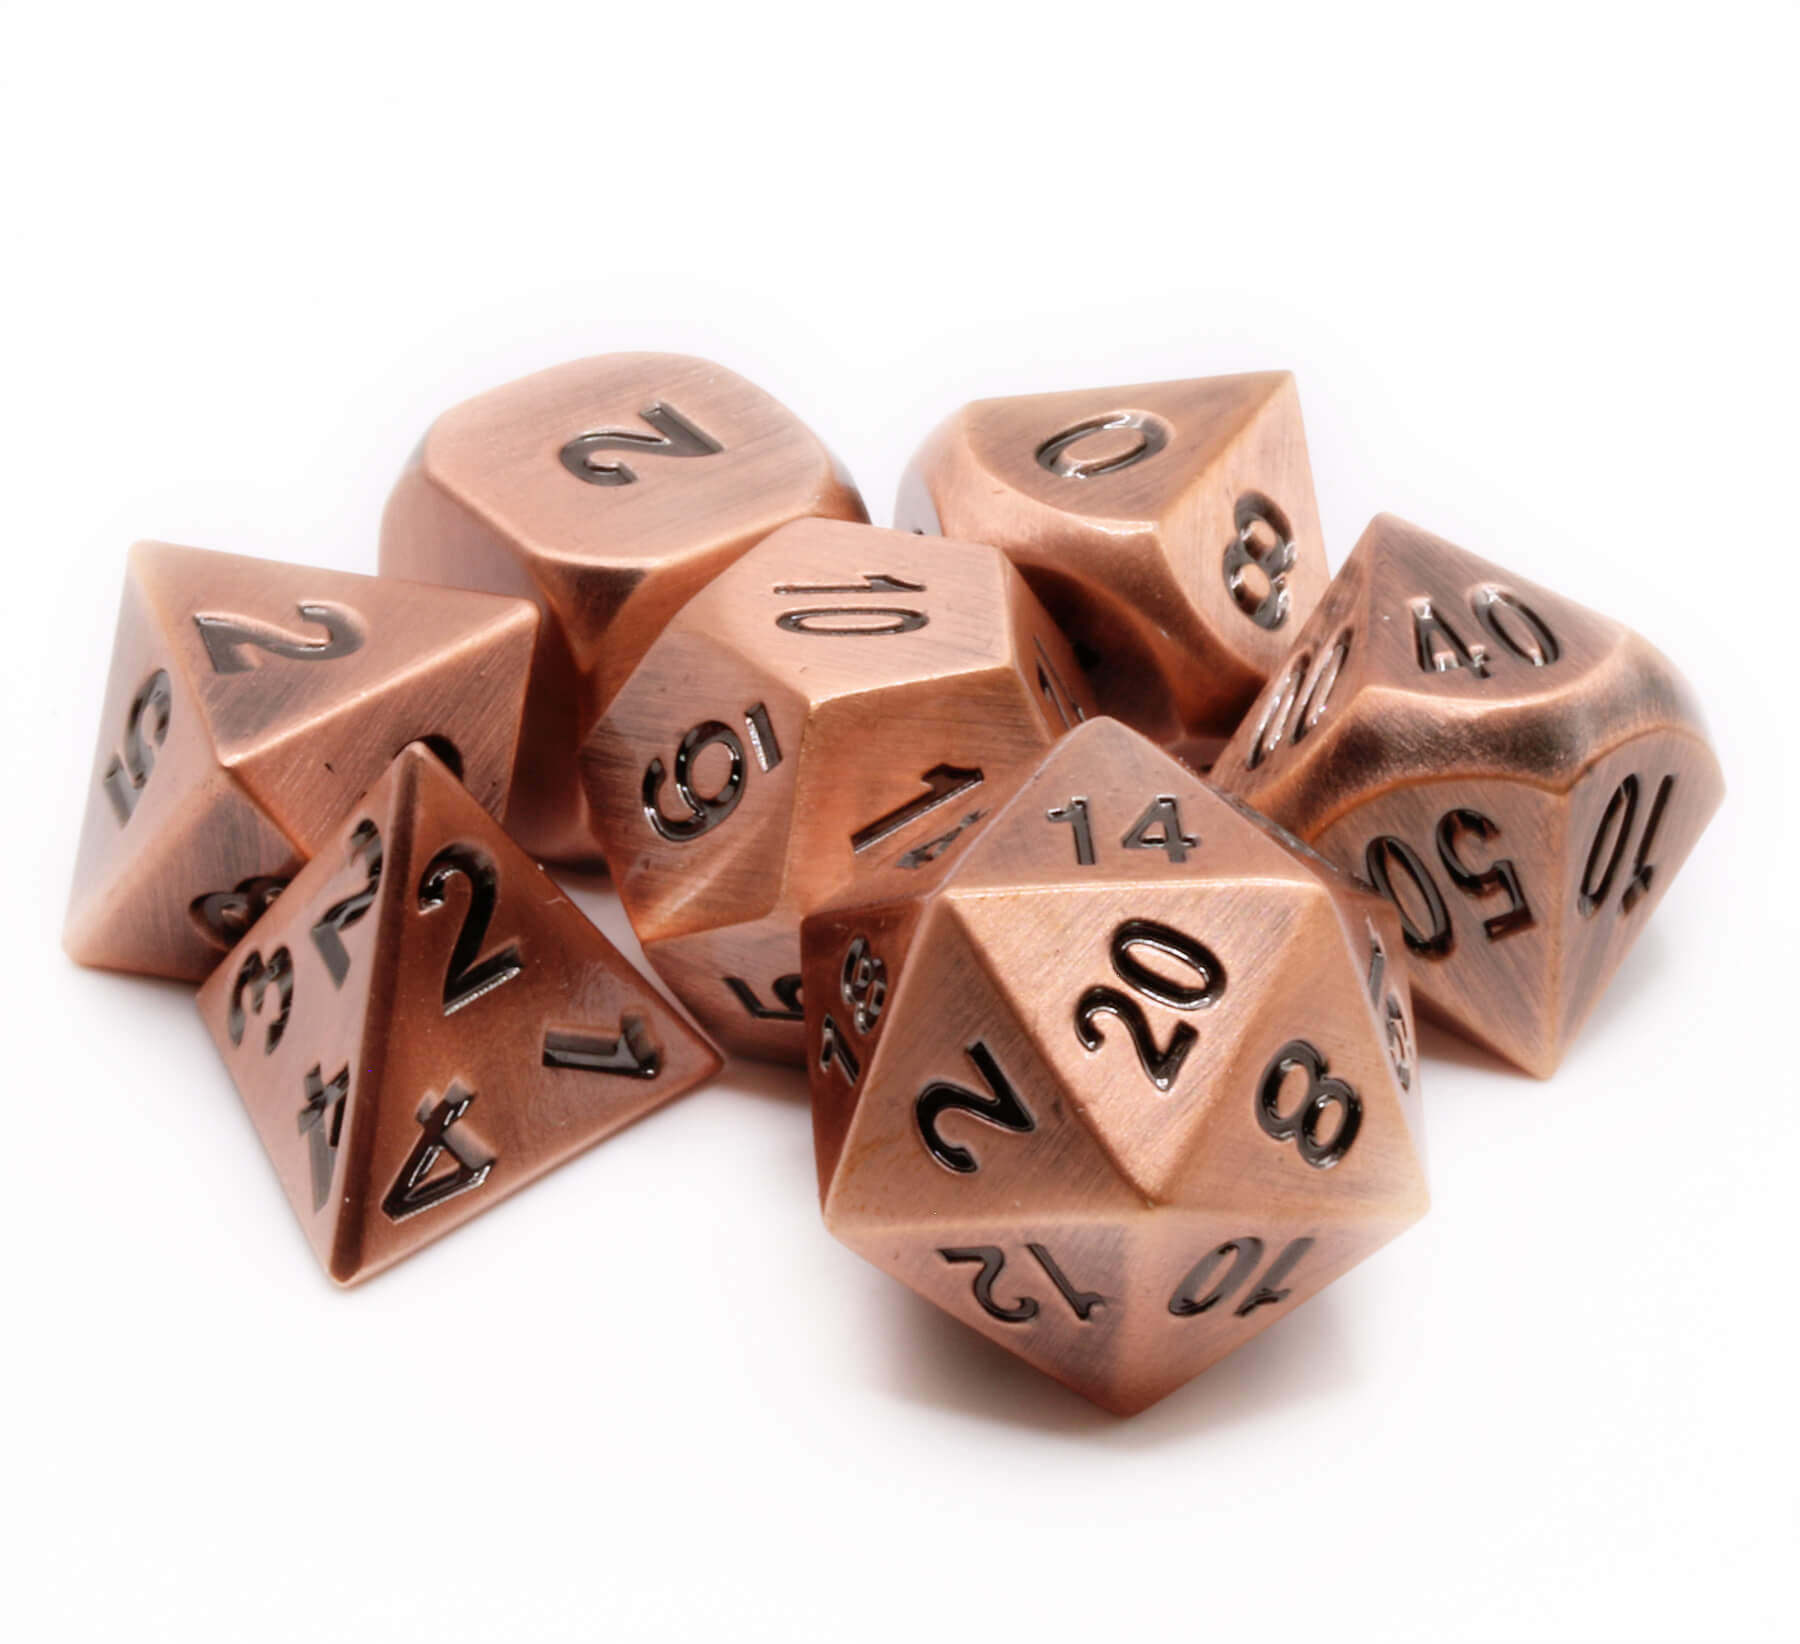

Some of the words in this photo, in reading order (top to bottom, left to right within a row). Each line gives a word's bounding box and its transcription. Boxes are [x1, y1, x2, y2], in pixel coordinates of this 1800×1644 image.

[559, 401, 725, 487] 2
[773, 573, 930, 636] 10
[1222, 489, 1297, 630] 8
[191, 601, 368, 675] 2
[1408, 582, 1561, 679] 40
[104, 668, 173, 830] 5
[1046, 795, 1202, 865] 14
[1366, 807, 1536, 961] 50
[1578, 772, 1676, 920] 10
[416, 840, 526, 1018] 2
[226, 943, 295, 1056] 3
[542, 1010, 665, 1081] 1
[1074, 917, 1228, 1093] 20
[379, 1076, 497, 1223] 4
[914, 1040, 1037, 1175] 2
[1254, 1039, 1364, 1170] 8
[934, 1240, 1109, 1324] 12
[1166, 1235, 1316, 1319] 10
